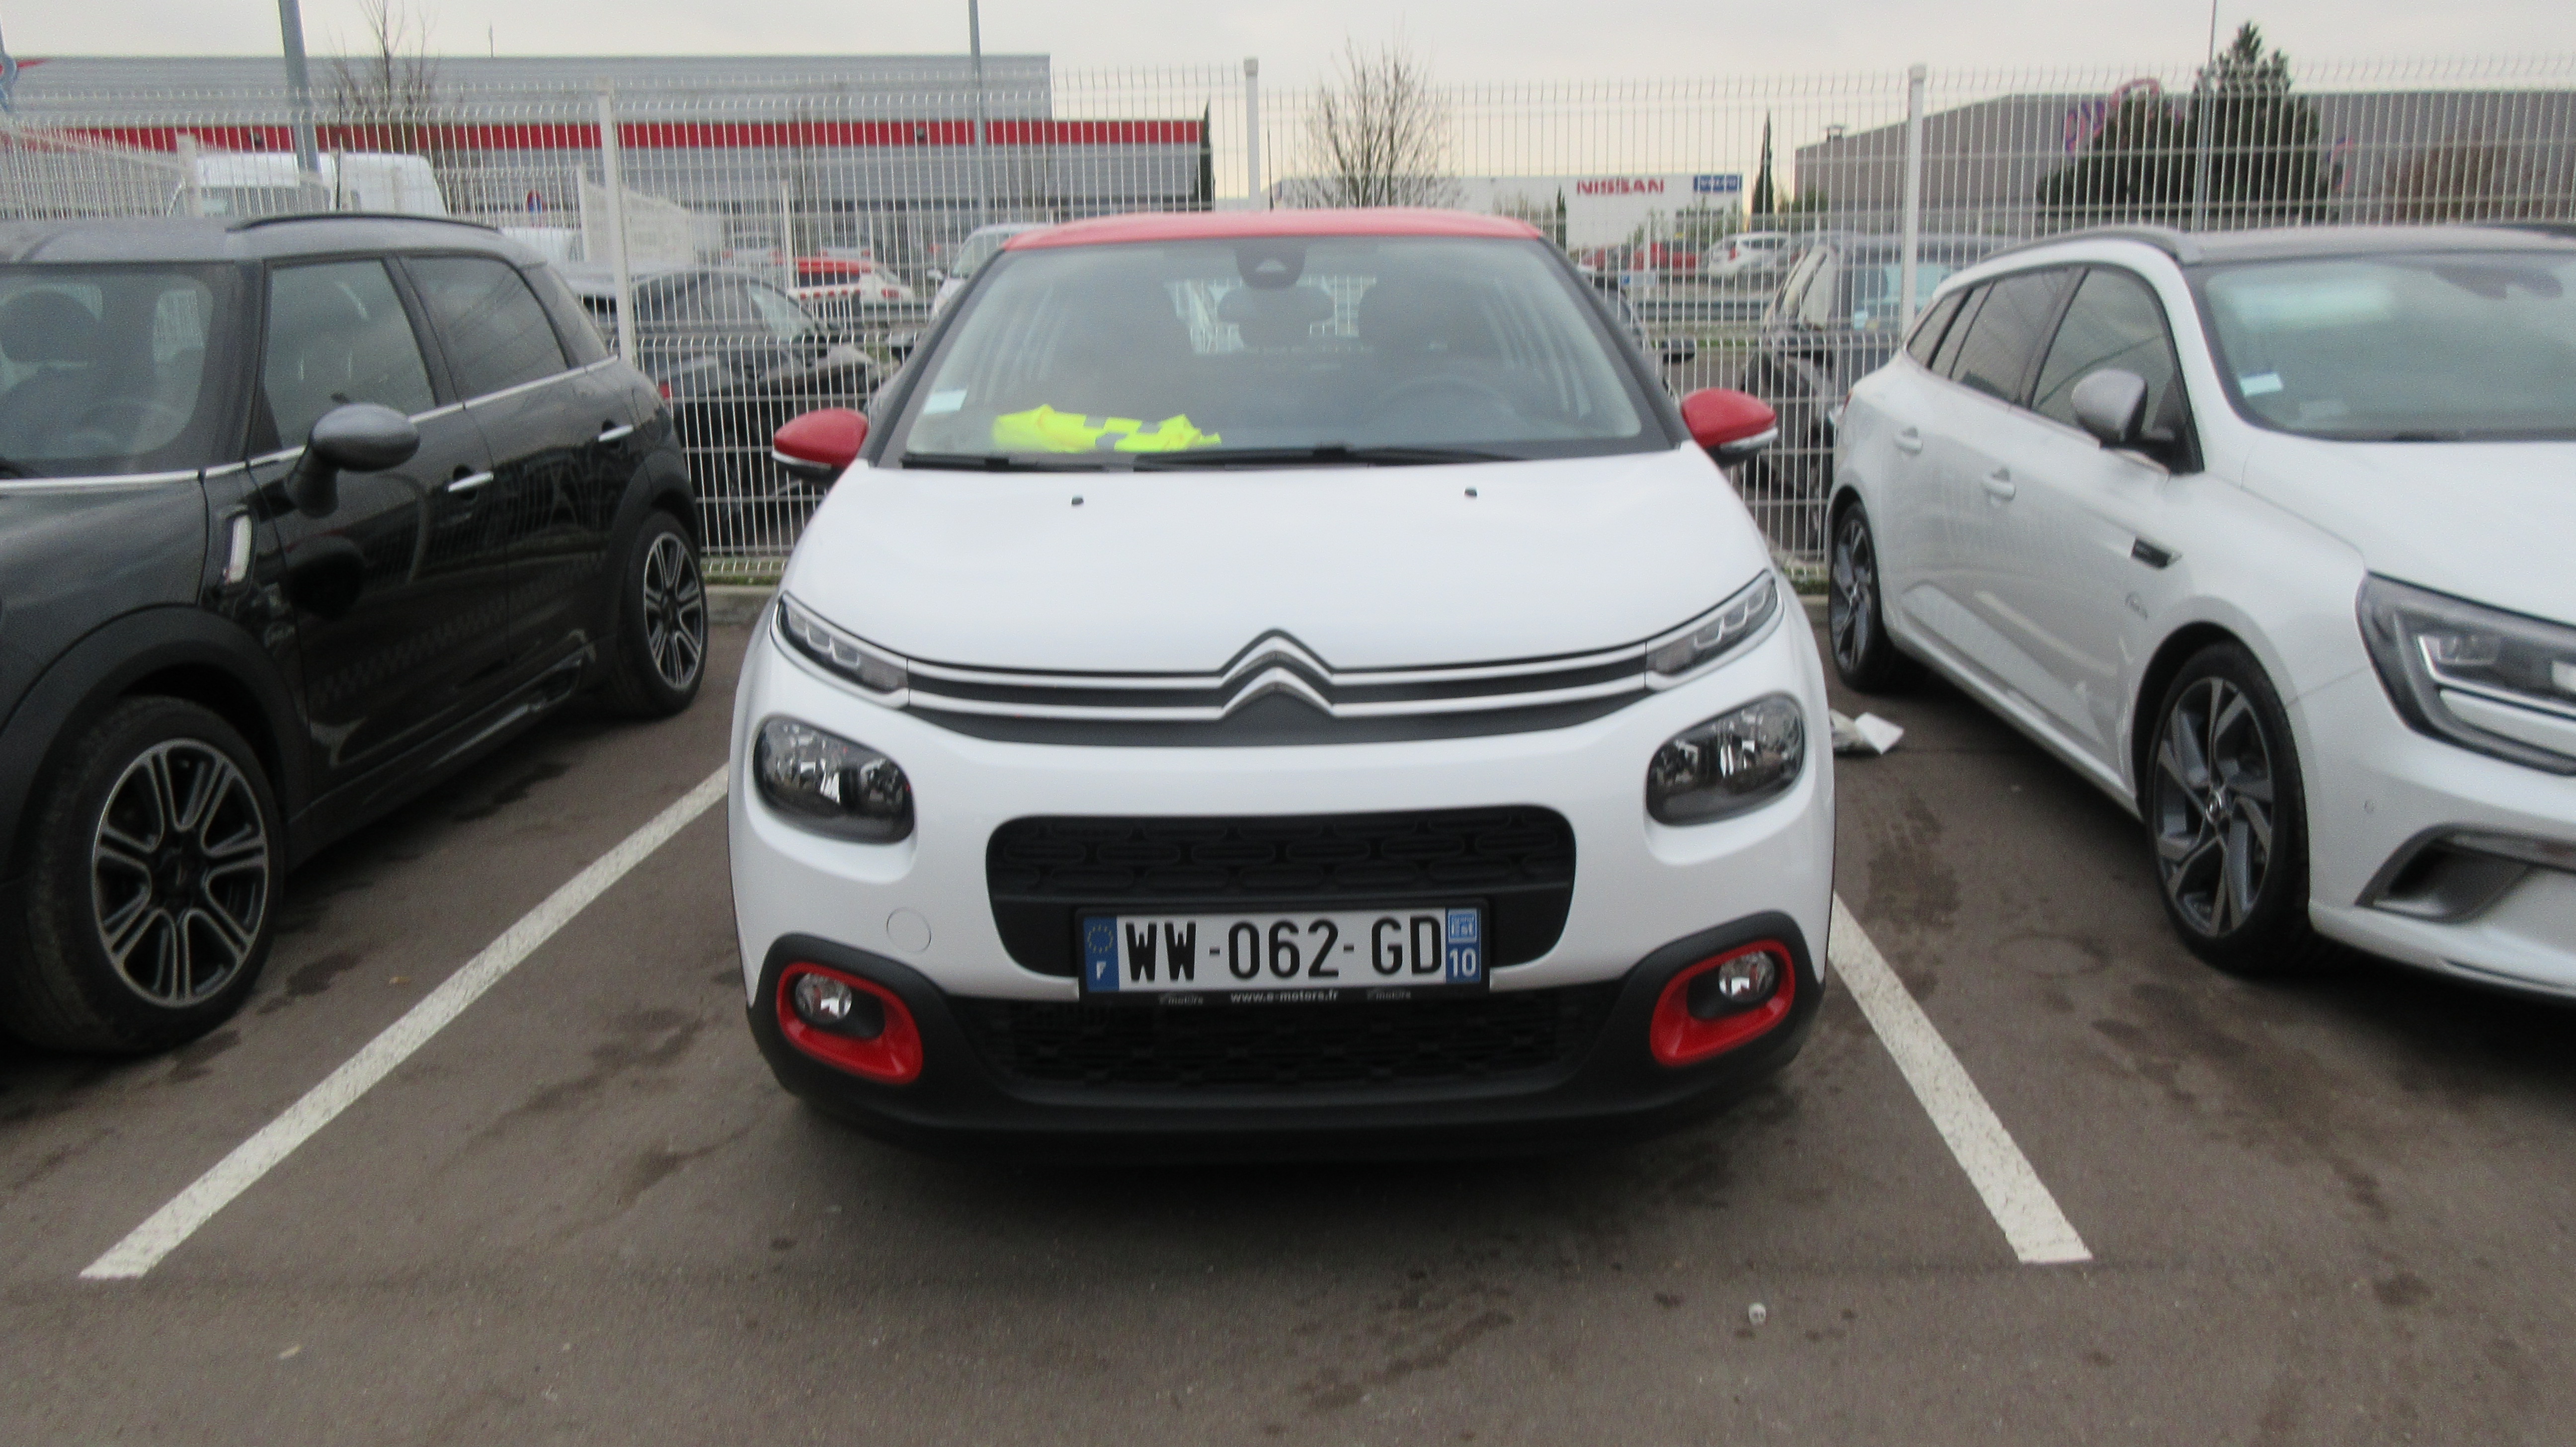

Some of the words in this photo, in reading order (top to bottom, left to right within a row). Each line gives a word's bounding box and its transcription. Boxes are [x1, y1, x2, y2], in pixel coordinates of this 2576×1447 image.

[1577, 177, 1664, 195] NISSAN
[1126, 916, 1442, 983] WW-062-GD
[1097, 961, 1107, 980] F
[1449, 948, 1476, 977] 10
[1230, 989, 1339, 1003] www.e-motors.fr
